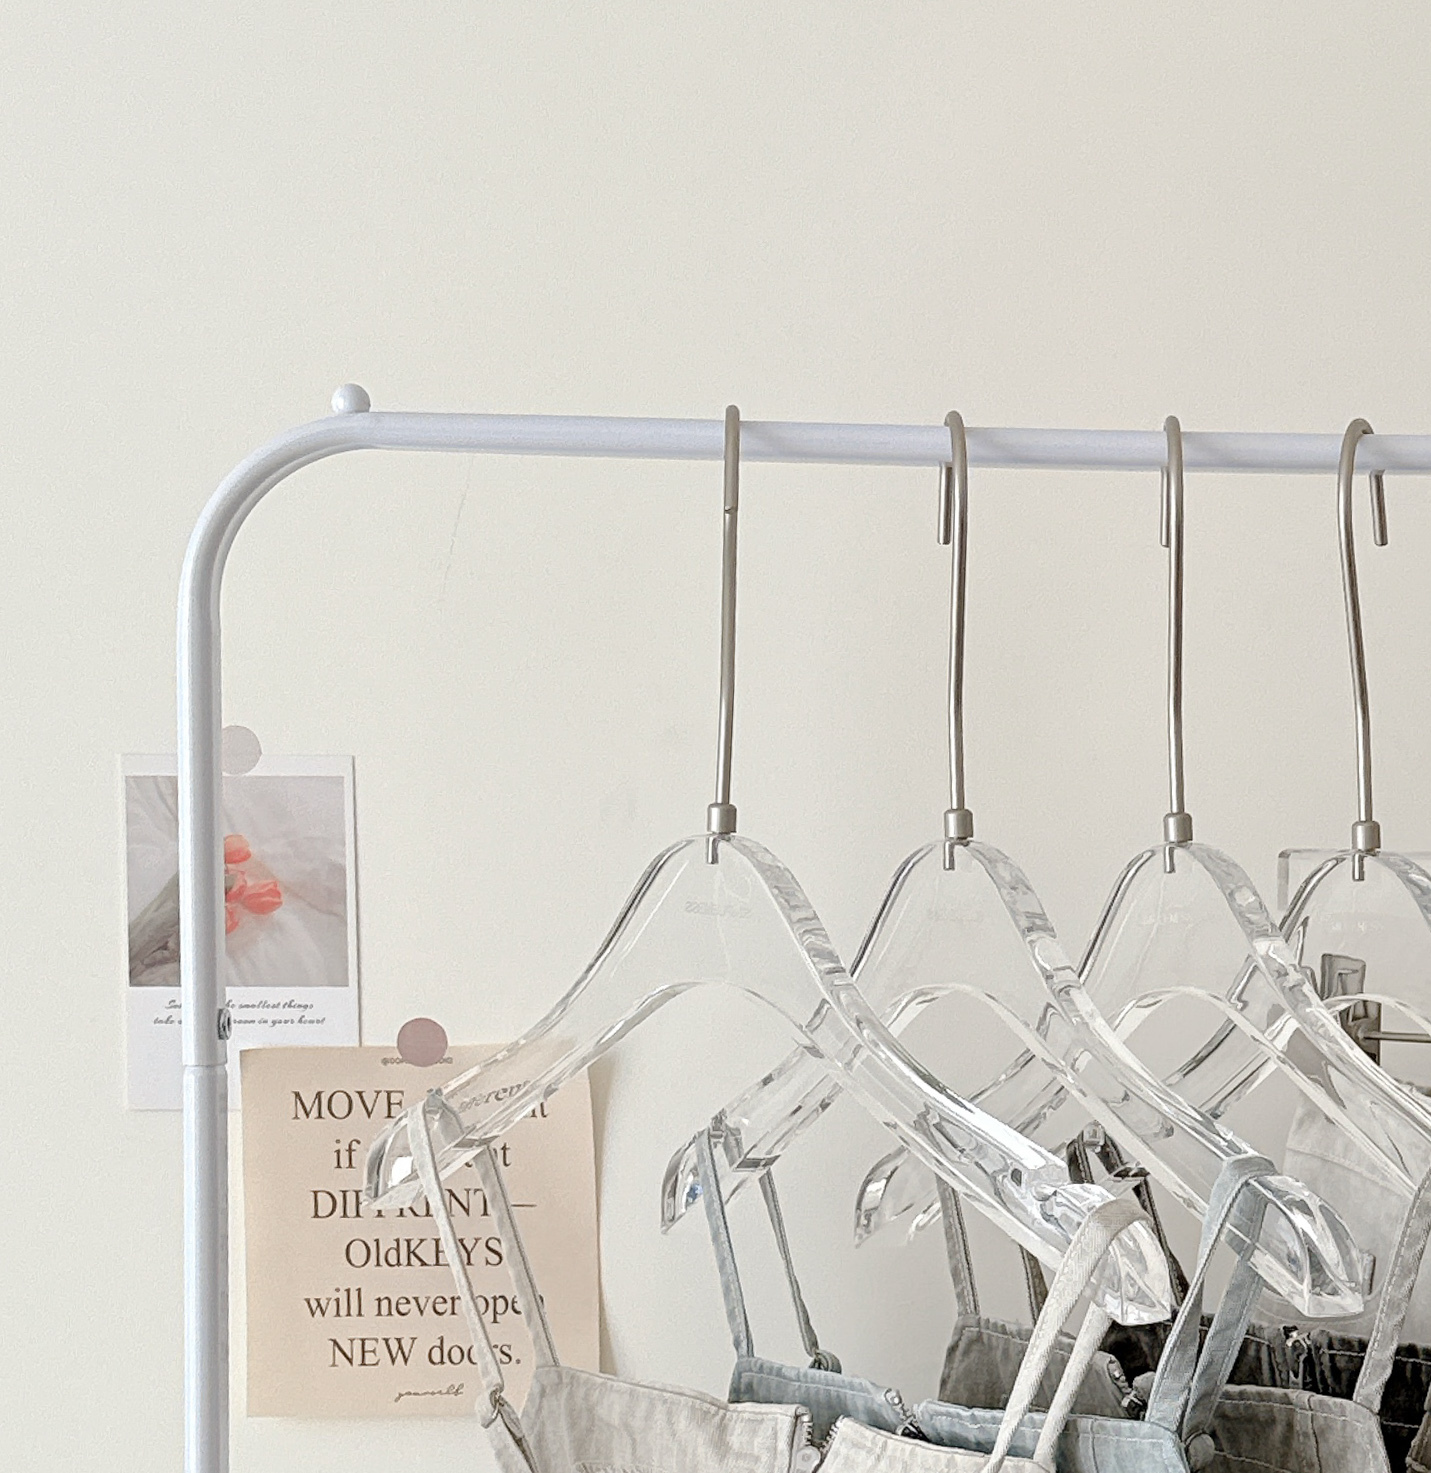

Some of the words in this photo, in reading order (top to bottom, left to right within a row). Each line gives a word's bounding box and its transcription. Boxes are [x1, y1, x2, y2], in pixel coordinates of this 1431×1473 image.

[282, 999, 314, 1012] things
[291, 1089, 406, 1120] MOVE
[333, 1139, 362, 1169] if
[344, 1236, 505, 1268] OldKEYS
[304, 1287, 365, 1318] will
[374, 1294, 462, 1317] never
[328, 1336, 418, 1367] NEW
